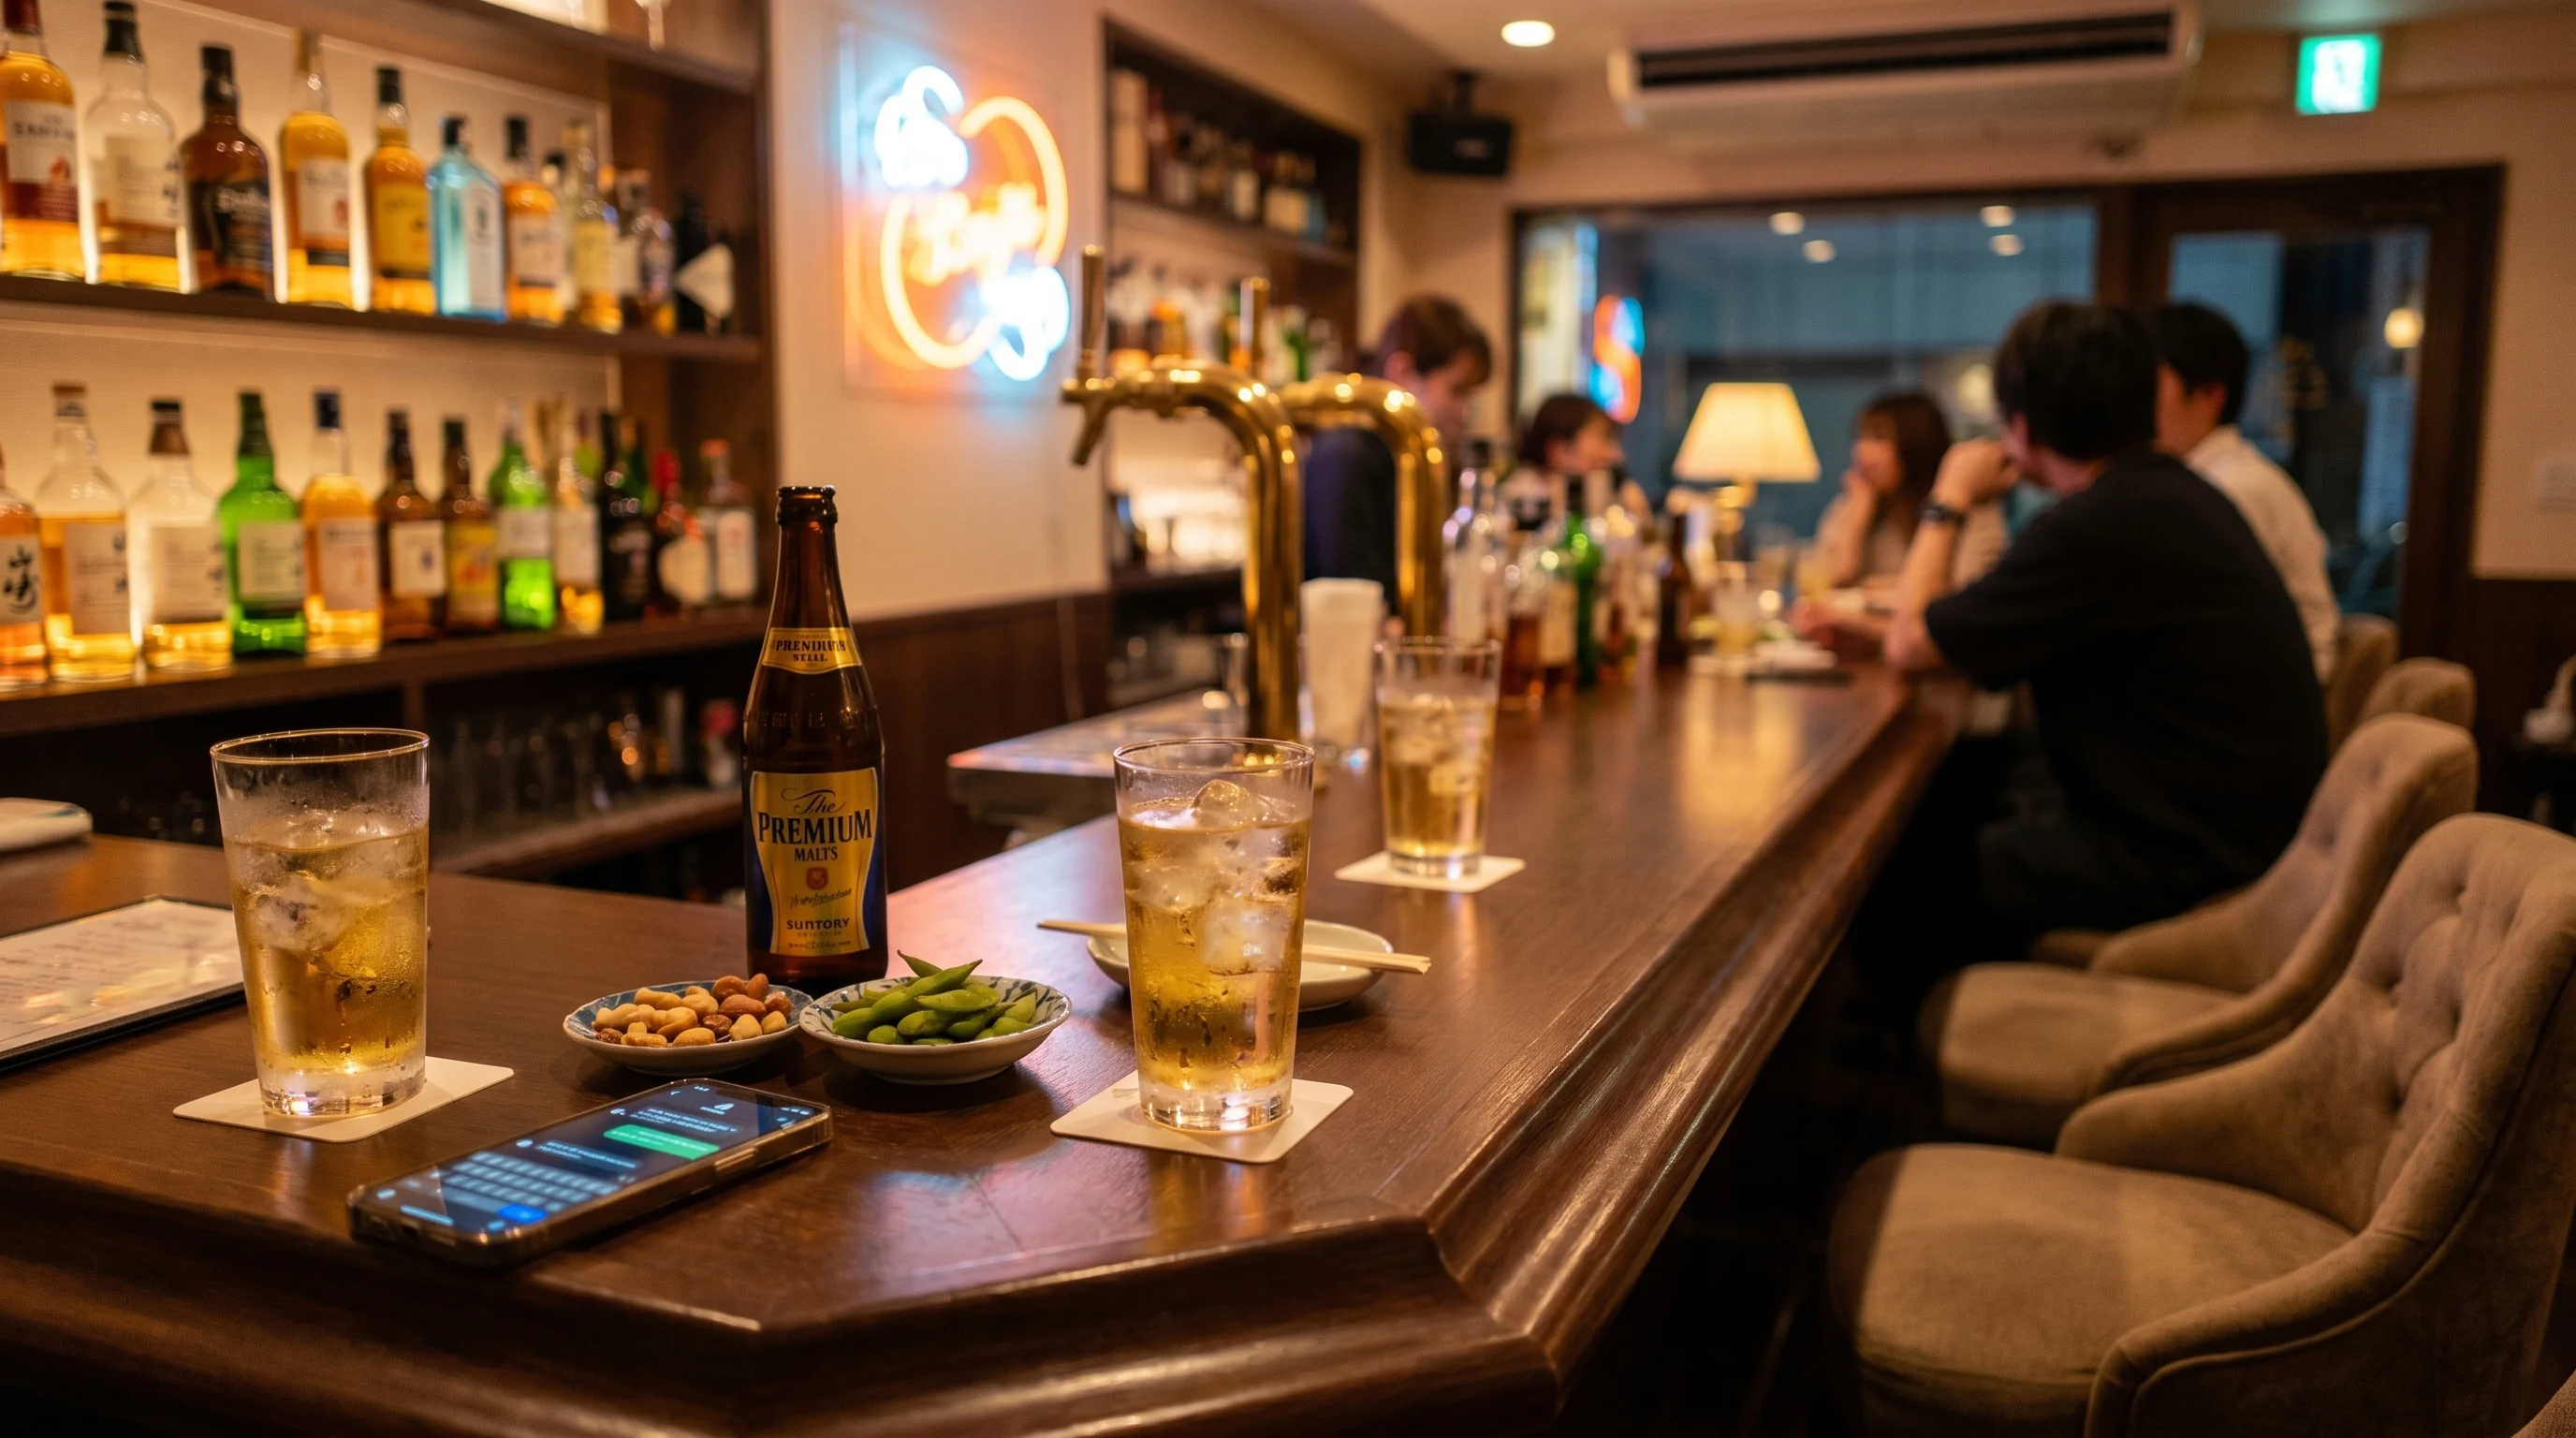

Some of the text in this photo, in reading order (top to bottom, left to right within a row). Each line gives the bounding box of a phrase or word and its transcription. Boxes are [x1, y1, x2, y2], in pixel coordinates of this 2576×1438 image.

[781, 787, 846, 814] The
[757, 808, 872, 844] PREMIUM
[794, 846, 839, 862] MALT'S
[786, 918, 850, 930] SUNTORY
